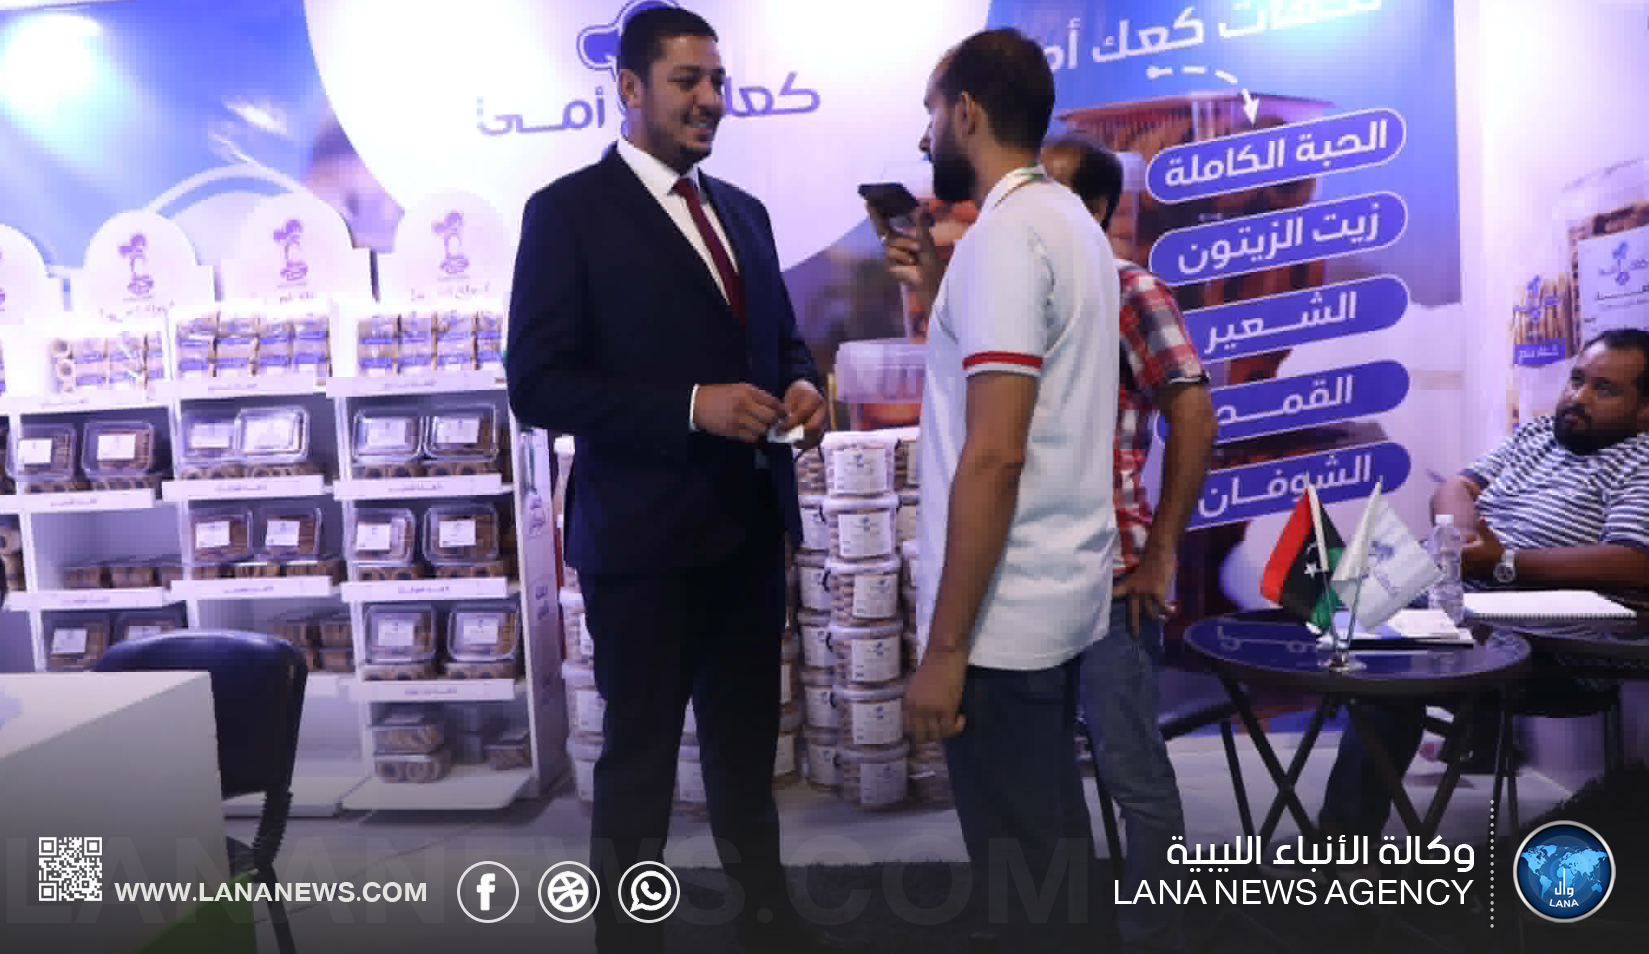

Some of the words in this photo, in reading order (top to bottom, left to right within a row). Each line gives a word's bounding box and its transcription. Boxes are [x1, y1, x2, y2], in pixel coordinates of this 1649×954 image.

[1043, 17, 1081, 70] أم
[1092, 5, 1204, 63] كعك
[723, 71, 820, 119] كع
[1164, 138, 1285, 189] الكاملة
[1296, 119, 1388, 167] الحبة
[1177, 217, 1303, 274] الزيتون
[1312, 202, 1381, 243] زيت
[1203, 291, 1357, 354] الشعير
[1197, 453, 1372, 518] الشوفان
